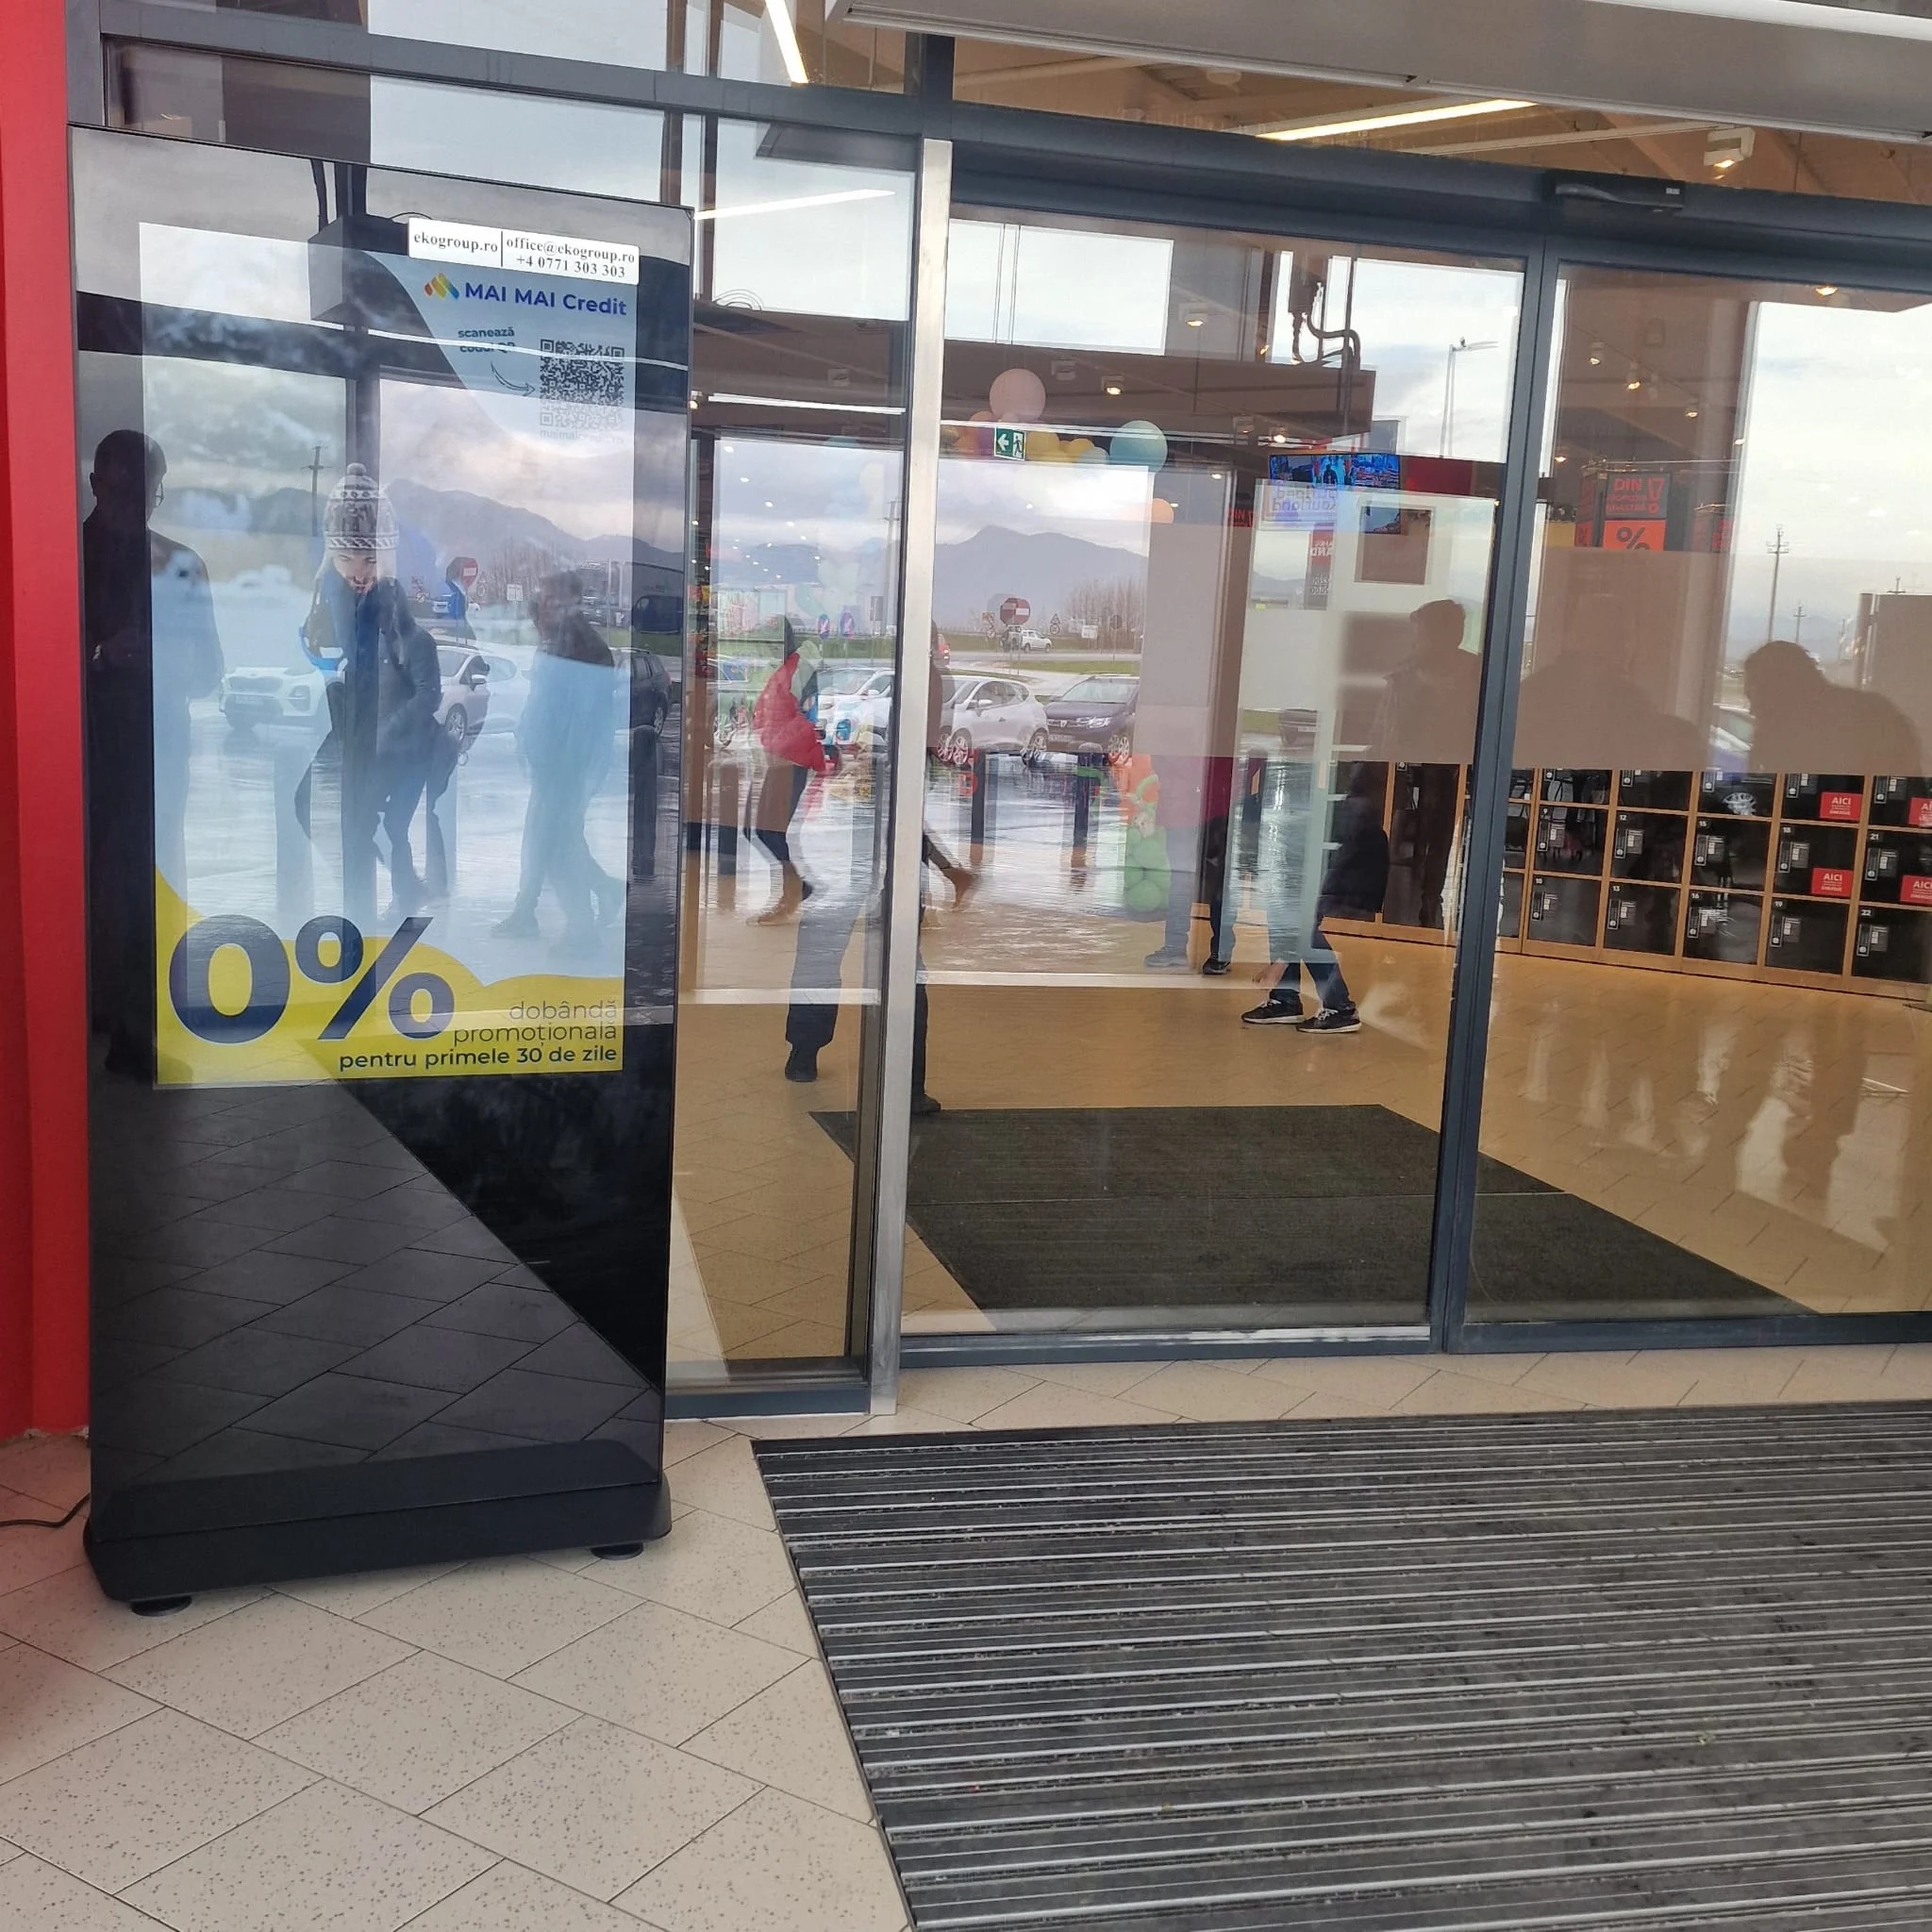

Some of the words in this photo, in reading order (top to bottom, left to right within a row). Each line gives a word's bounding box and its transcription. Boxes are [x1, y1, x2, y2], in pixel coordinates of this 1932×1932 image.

[414, 231, 498, 253] ekogroup.ro
[507, 236, 635, 264] office@ekogroup.ro
[516, 255, 534, 268] +4
[538, 257, 569, 272] 0771
[574, 260, 598, 275] 303
[602, 263, 625, 278] 303
[465, 282, 507, 302] MAI
[514, 288, 555, 308] MAI
[563, 293, 626, 315] Credit
[458, 325, 515, 339] scanează
[1832, 796, 1851, 805] AICI
[1823, 873, 1842, 881] AICI
[169, 914, 455, 1045] 0%
[509, 1000, 616, 1020] dobândă
[454, 1021, 616, 1047] promoțională
[340, 1052, 416, 1072] pentru
[425, 1048, 510, 1069] primele
[517, 1047, 542, 1063] 30
[549, 1046, 576, 1062] de
[582, 1045, 617, 1061] zile
